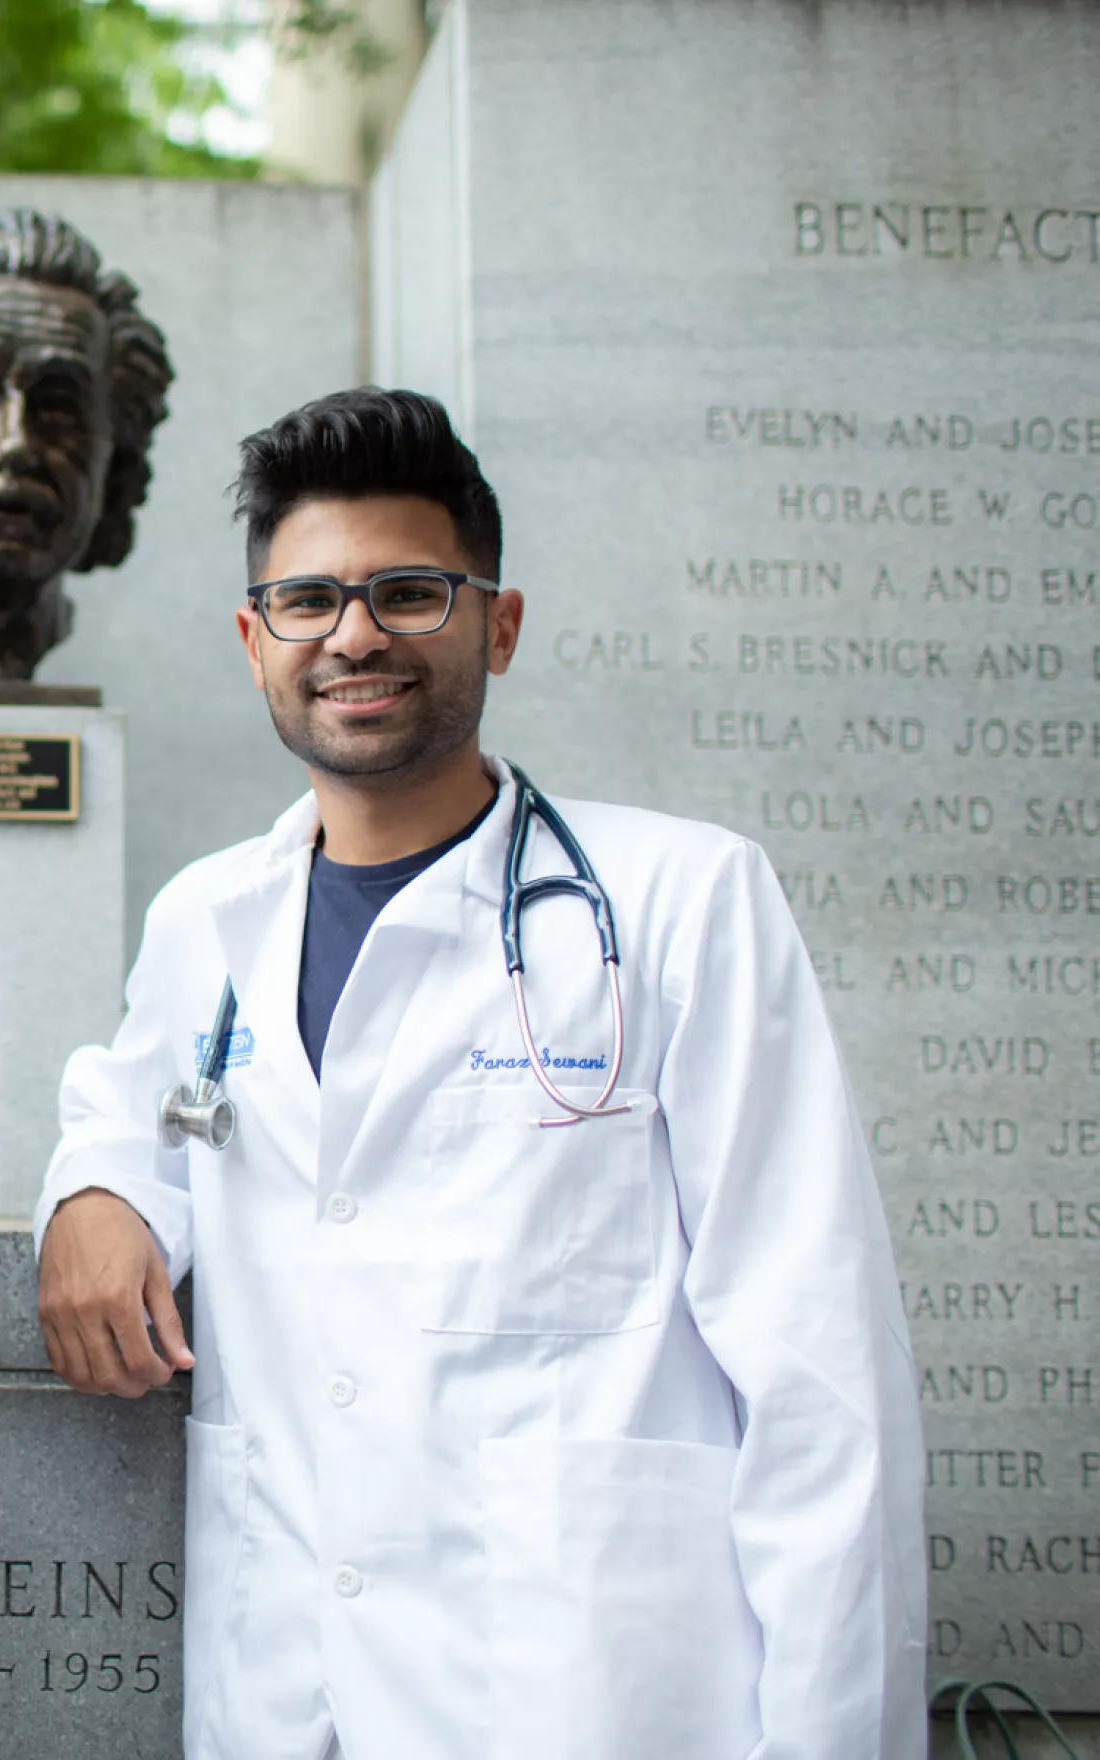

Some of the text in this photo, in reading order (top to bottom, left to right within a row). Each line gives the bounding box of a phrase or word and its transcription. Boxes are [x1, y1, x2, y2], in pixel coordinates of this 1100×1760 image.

[793, 202, 1100, 263] BENEFACT
[705, 407, 857, 446] EVELYN
[885, 414, 973, 450] AND
[777, 484, 953, 525] HORACE
[1041, 493, 1097, 530] GO
[685, 557, 843, 596] MARTIN
[923, 565, 1012, 602] AND
[738, 634, 950, 678] BRESNICK
[973, 643, 1063, 680] AND
[691, 710, 807, 750] LEILA
[836, 716, 925, 753] AND
[762, 791, 871, 831] LOLA
[904, 796, 995, 835] AND
[878, 873, 970, 912] AND
[886, 953, 977, 992] AND
[920, 1035, 1049, 1075] DAVID
[927, 1116, 1019, 1156] AND
[907, 1198, 1001, 1238] AND
[920, 1365, 1009, 1402] AND
[0, 1560, 179, 1621] EINS
[926, 1620, 1084, 1658] D AND
[40, 1649, 160, 1693] 1955
